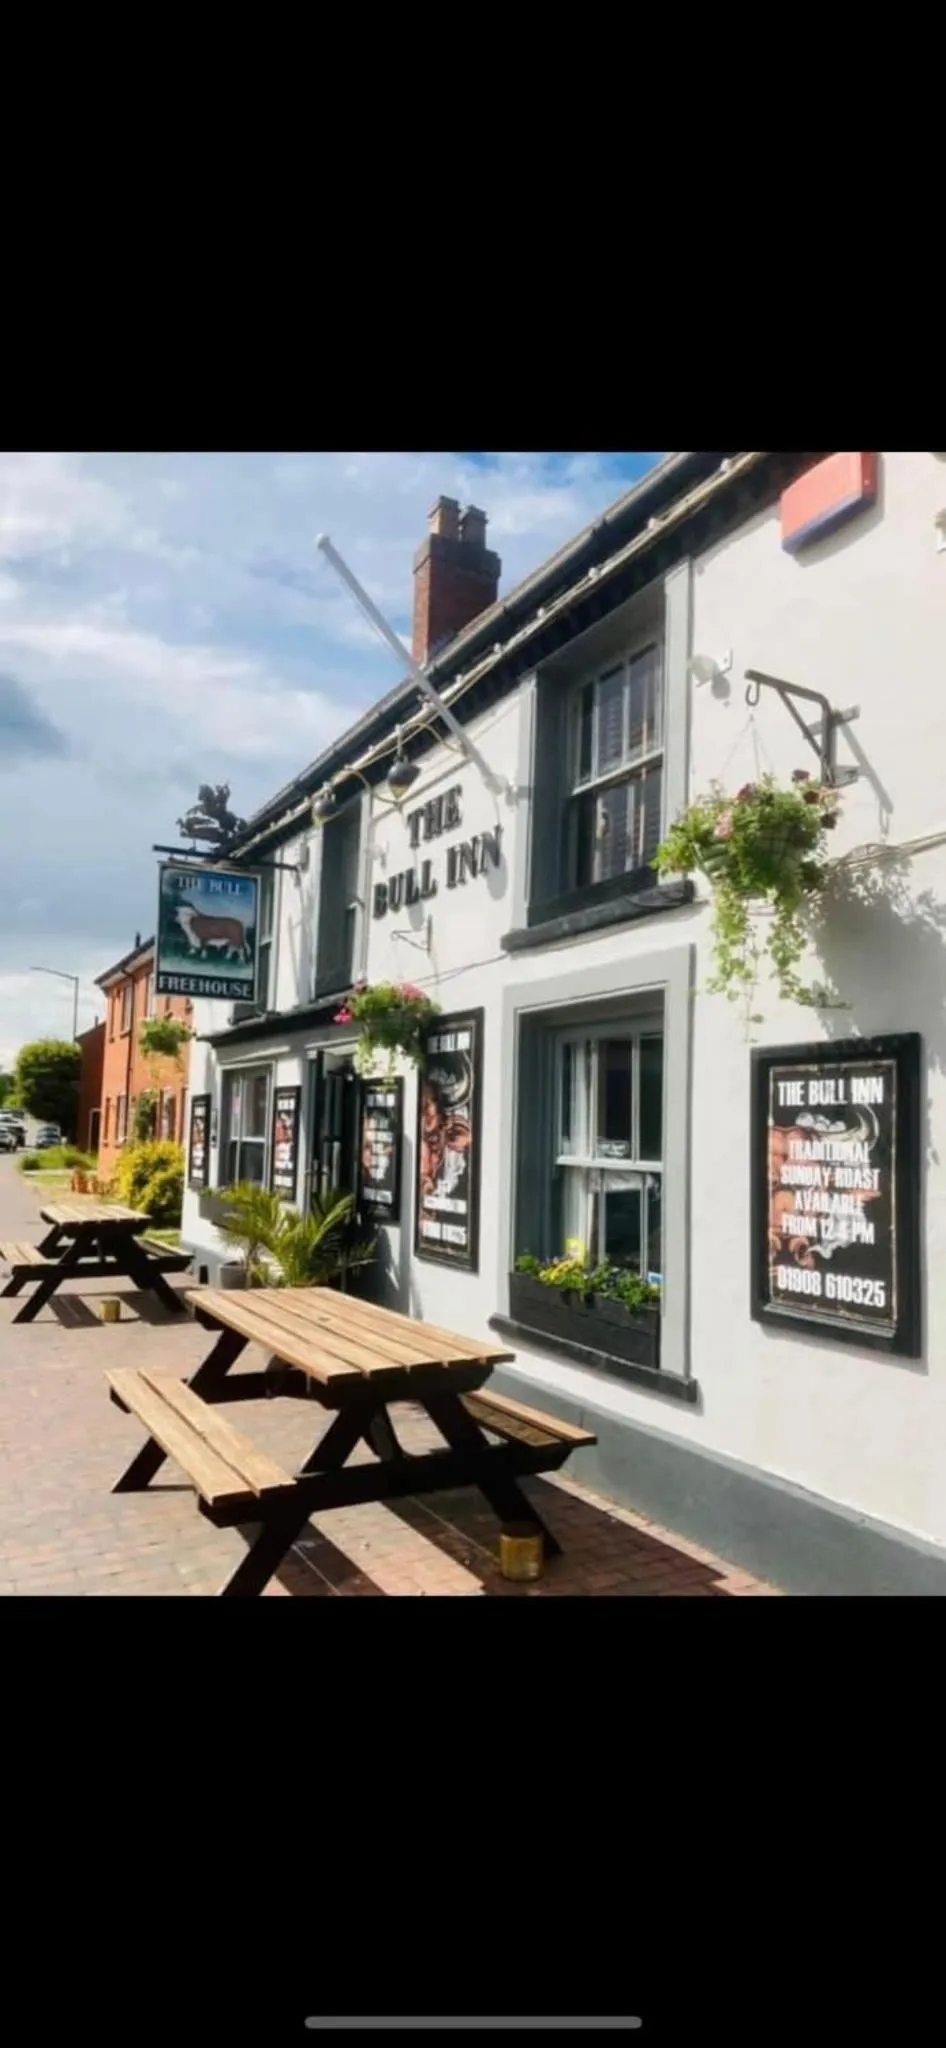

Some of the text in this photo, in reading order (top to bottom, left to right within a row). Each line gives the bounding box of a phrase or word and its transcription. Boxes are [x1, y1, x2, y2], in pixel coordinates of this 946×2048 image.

[407, 784, 463, 848] THE
[177, 876, 241, 896] THE BULL
[373, 823, 504, 920] BULL INN
[159, 975, 251, 997] FREEHOUSE
[778, 1076, 884, 1106] THE BULL INN
[789, 1139, 871, 1163] TRADITIONAL
[780, 1163, 881, 1192] SUNDAY ROAST
[794, 1190, 865, 1215] AVAILABLE
[781, 1213, 817, 1237] FROM
[852, 1220, 875, 1245] PM
[777, 1264, 886, 1308] 01908 610325
